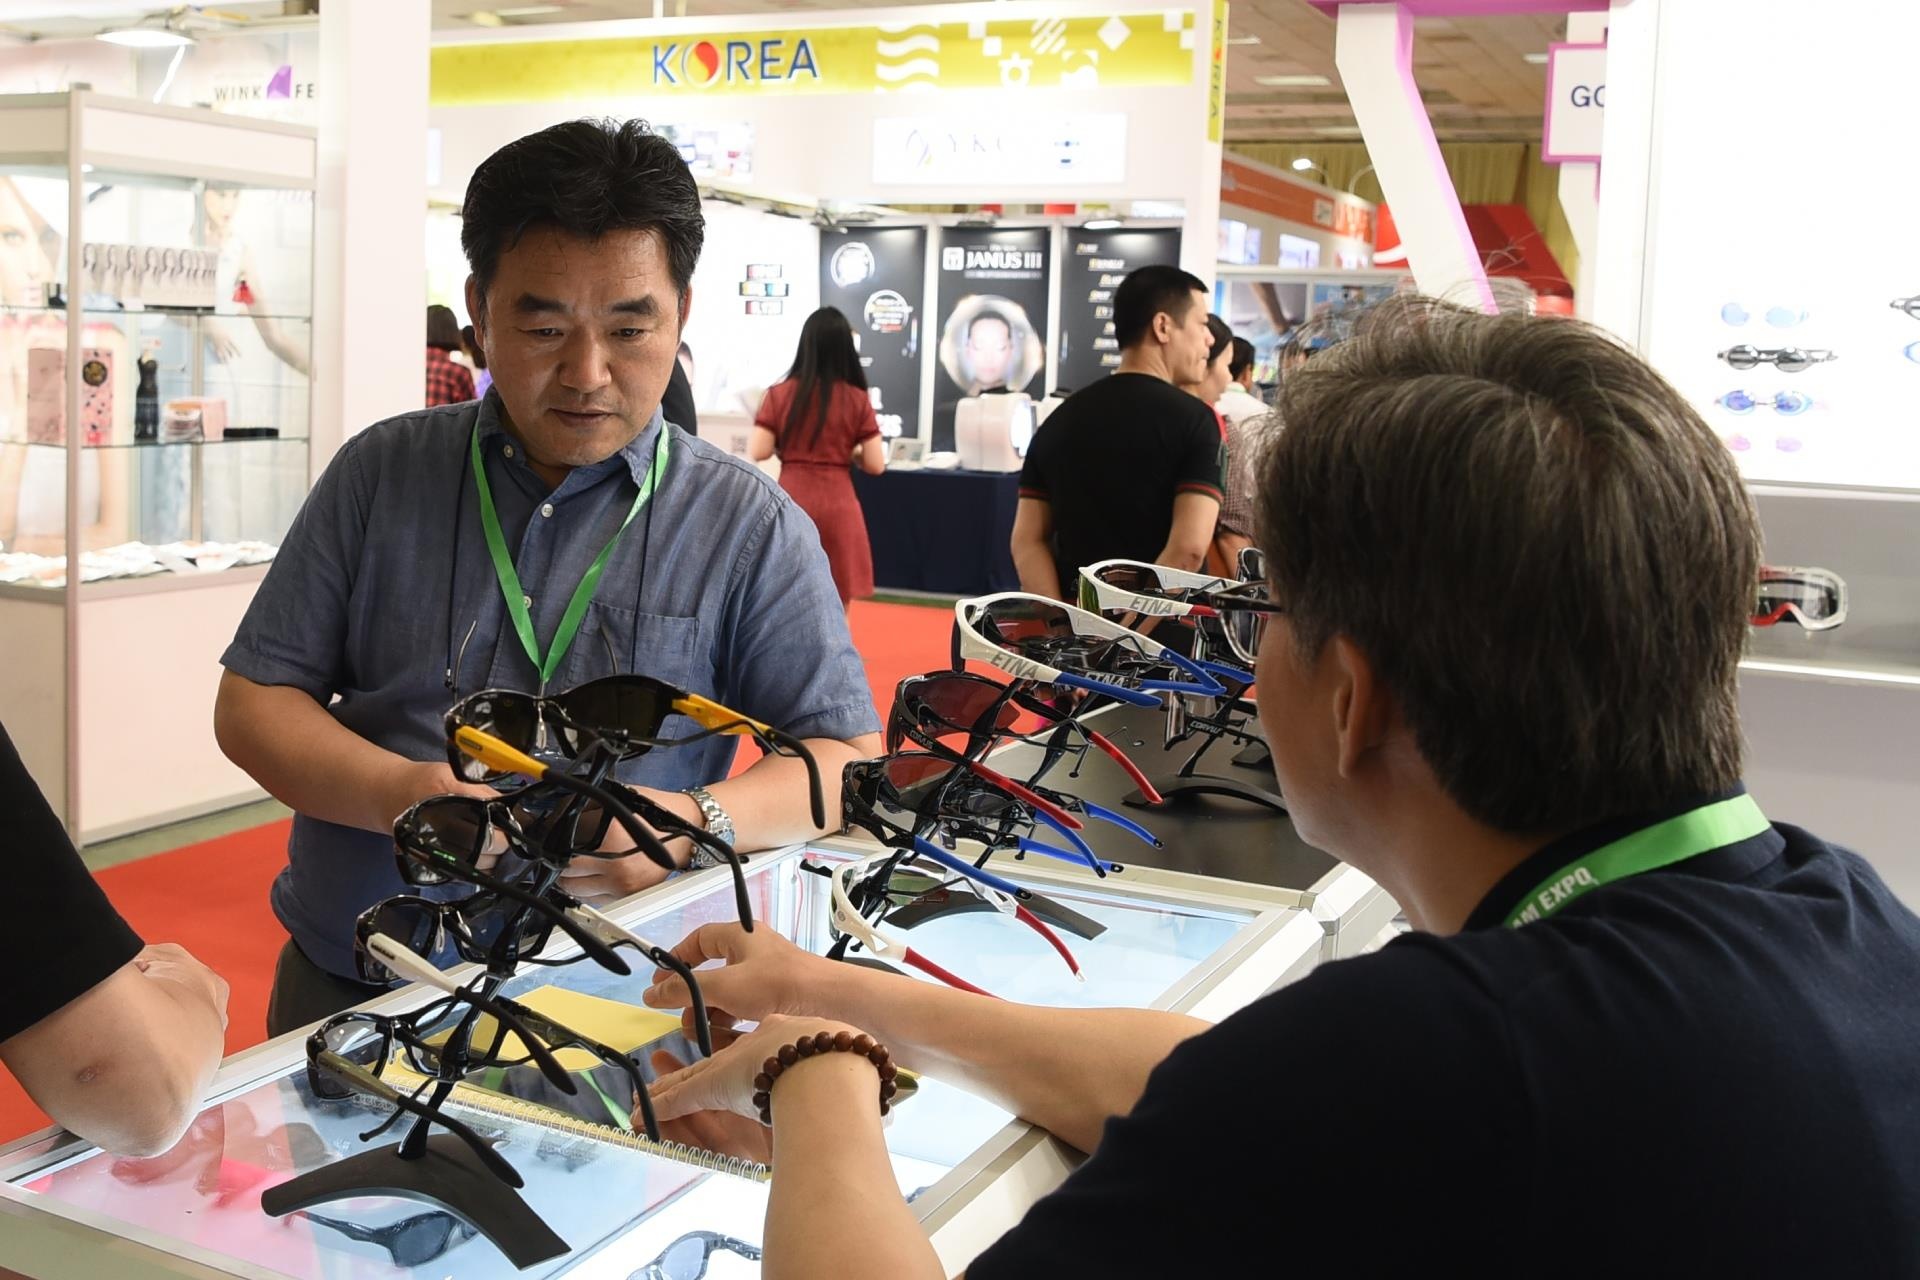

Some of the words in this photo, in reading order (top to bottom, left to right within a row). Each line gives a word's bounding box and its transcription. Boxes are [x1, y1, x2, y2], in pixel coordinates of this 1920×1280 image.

[653, 38, 818, 89] KOREA
[214, 87, 262, 101] WINK
[966, 251, 1023, 270] JANUS
[1129, 596, 1174, 614] ETNA
[990, 653, 1039, 680] ETNA
[1537, 867, 1593, 911] EXPO
